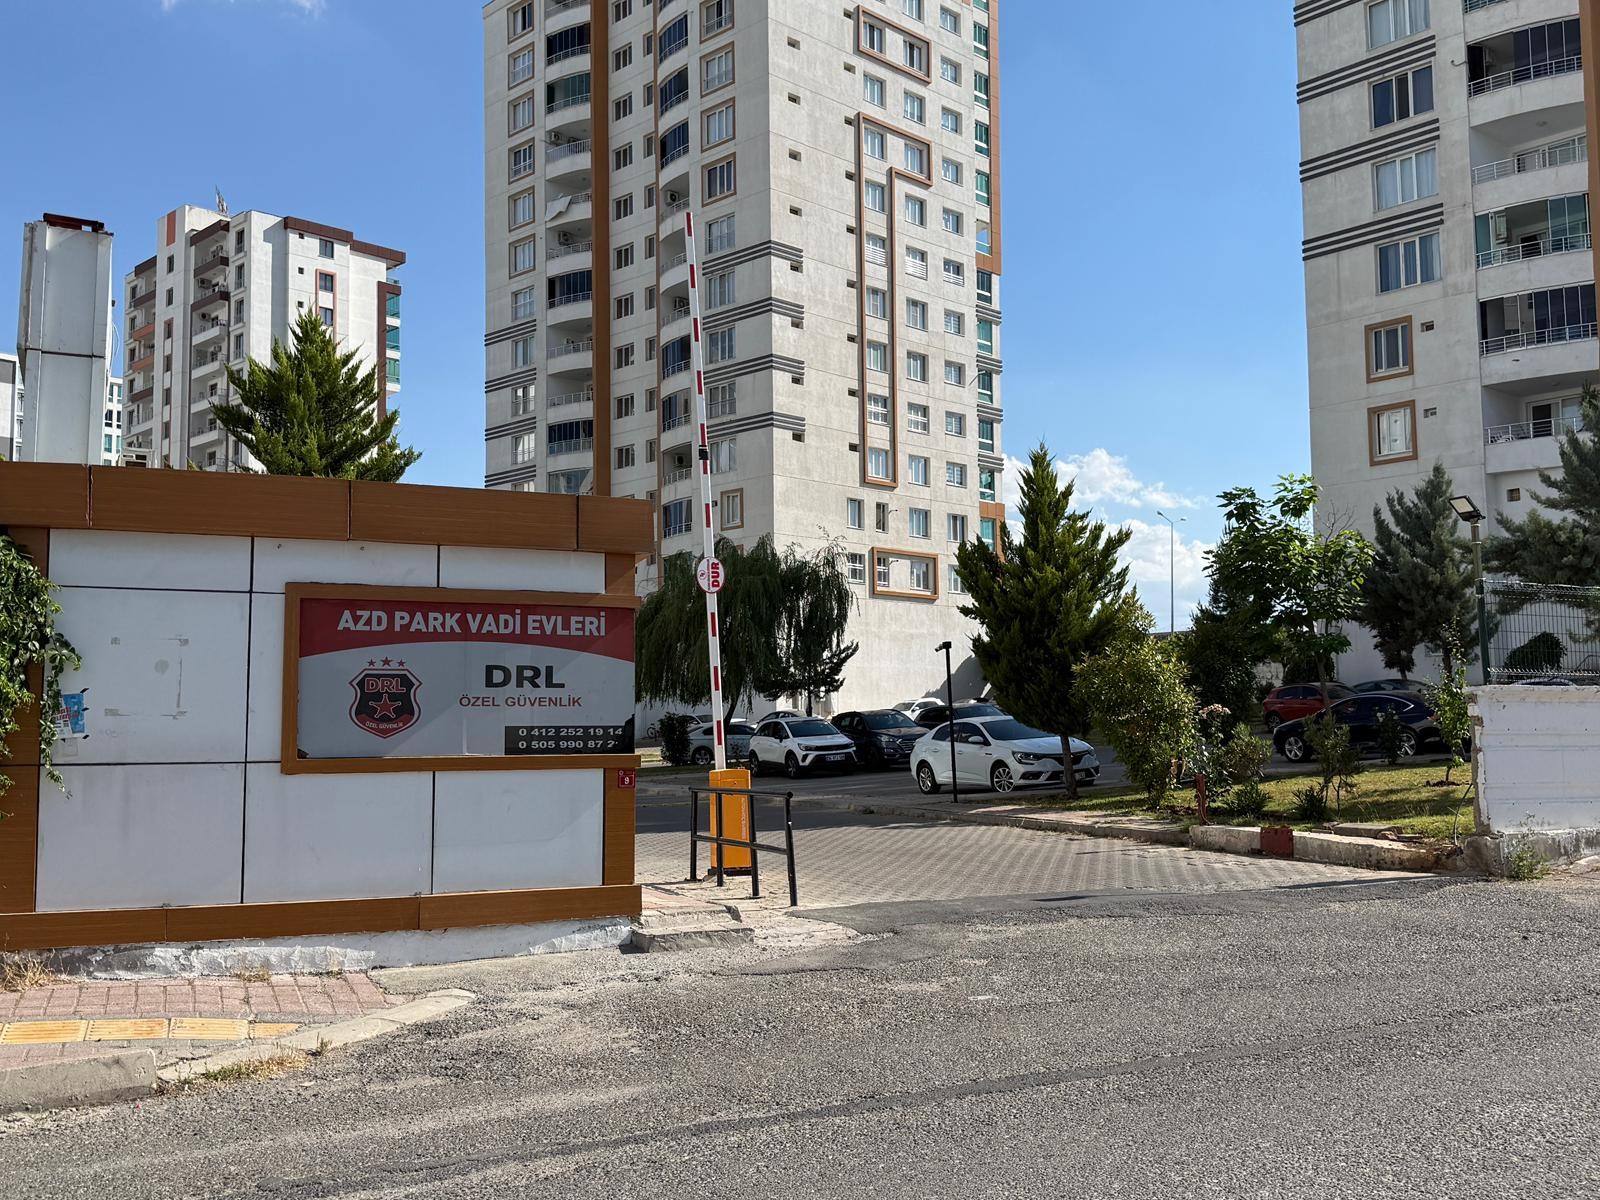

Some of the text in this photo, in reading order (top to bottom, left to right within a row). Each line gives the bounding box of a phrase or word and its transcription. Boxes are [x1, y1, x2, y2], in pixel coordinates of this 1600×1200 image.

[710, 561, 721, 588] DUR
[337, 608, 606, 636] AZD PARK VADİ EVLERİ
[485, 664, 566, 689] DRL
[364, 677, 407, 693] DRL
[459, 694, 583, 707] ÖZEL GÜVENLİK
[518, 727, 623, 736] 0 412 252 19 14
[518, 740, 619, 749] 0 505 990 87 2
[624, 776, 630, 785] 9
